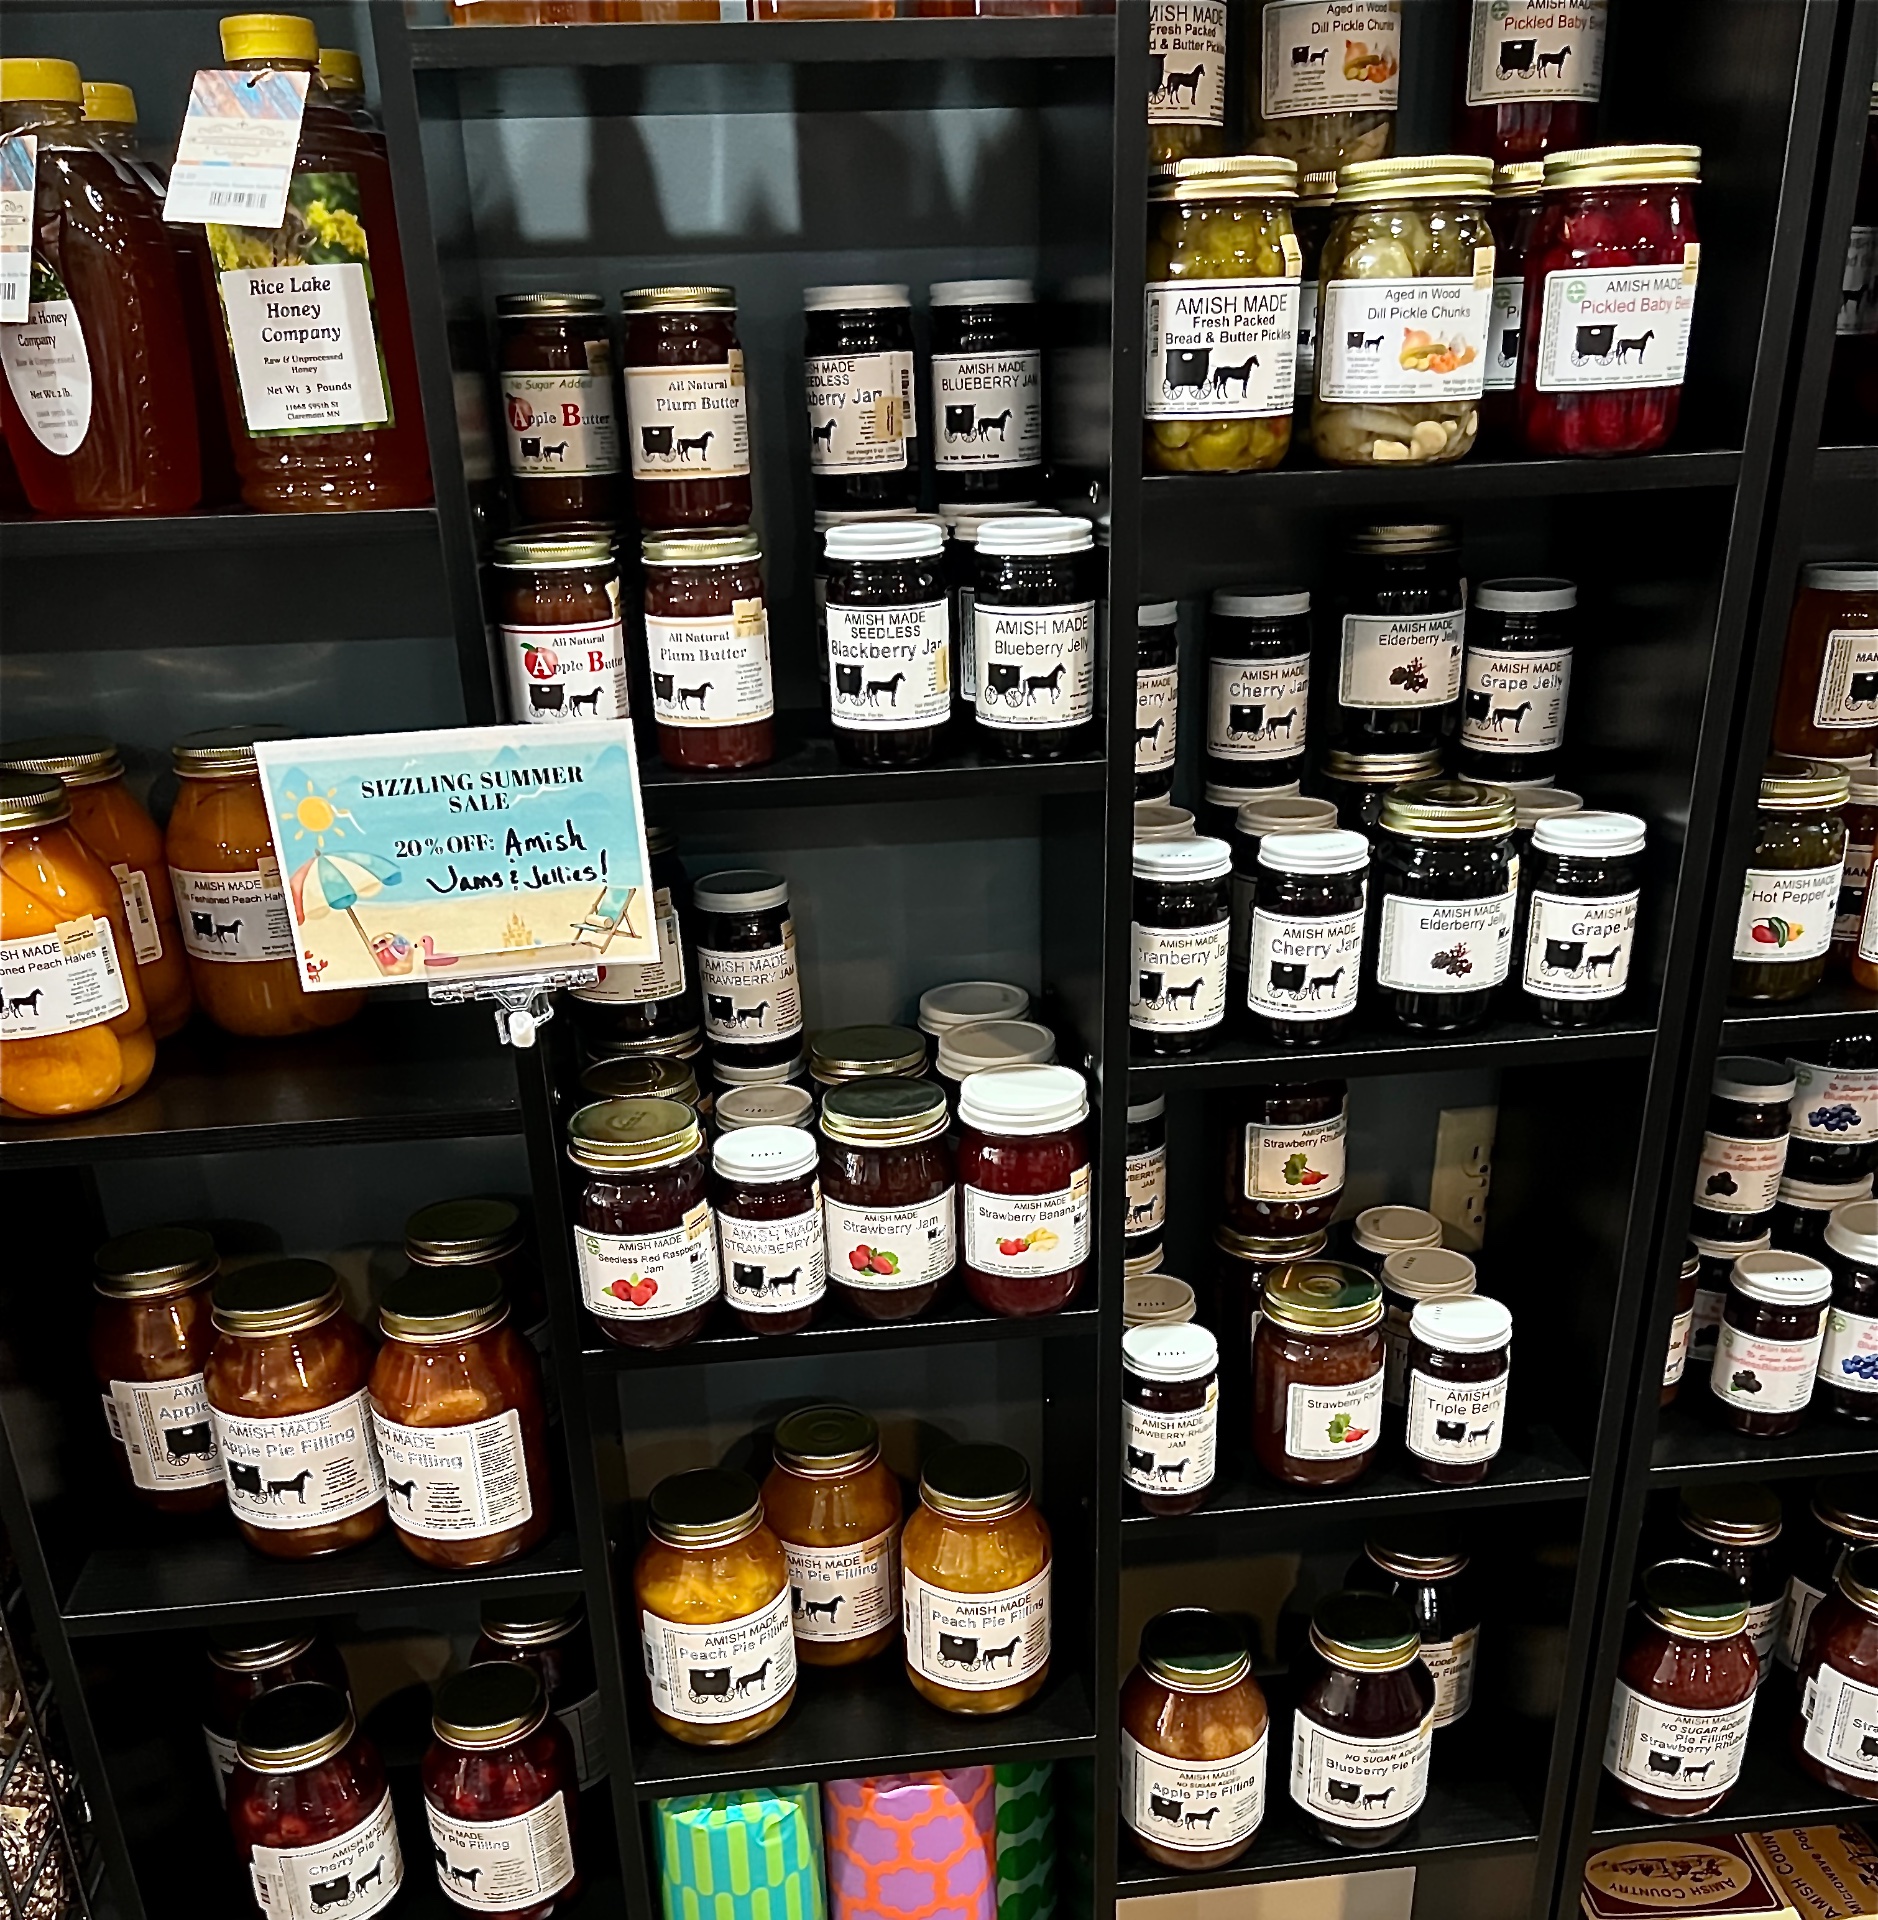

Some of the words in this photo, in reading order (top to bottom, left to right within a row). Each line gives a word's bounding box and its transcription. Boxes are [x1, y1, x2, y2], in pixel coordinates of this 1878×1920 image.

[1326, 3, 1353, 17] Aged
[1355, 4, 1364, 13] in
[1184, 23, 1217, 38] Packed
[1311, 21, 1329, 35] Dill
[1332, 19, 1365, 32] Pickle
[1504, 13, 1554, 31] Pickled
[1557, 14, 1587, 33] Baby
[1172, 38, 1205, 51] Butter
[249, 278, 285, 296] Rice
[289, 276, 332, 293] Lake
[1605, 279, 1650, 294] AMISH
[1384, 288, 1416, 303] Aged
[1417, 289, 1428, 300] in
[1431, 287, 1461, 300] Wood
[266, 302, 322, 320] Honey
[1175, 296, 1239, 316] AMISH
[1243, 293, 1288, 314] MADE
[1367, 307, 1387, 320] Dill
[1390, 305, 1428, 319] Pickle
[1431, 305, 1471, 319] Chunks
[1580, 299, 1637, 316] Pickled
[1640, 297, 1674, 314] Baby
[37, 310, 68, 327] Honey
[1192, 315, 1231, 329] Fresh
[1233, 313, 1276, 328] Packed
[17, 333, 57, 350] Company
[261, 326, 342, 344] Company
[1164, 331, 1201, 345] Bread
[1205, 331, 1216, 343] &
[1219, 330, 1260, 344] Butter
[291, 352, 344, 364] Unprocessed
[291, 366, 318, 374] Honey
[821, 360, 856, 374] MADE
[957, 363, 995, 376] AMISH
[266, 385, 284, 396] Net
[305, 386, 312, 395] 3
[316, 382, 353, 393] Pounds
[523, 378, 556, 392] Sugar
[941, 375, 1019, 391] BLUEBERRY
[655, 397, 697, 412] Plum
[700, 396, 740, 411] Butter
[326, 410, 341, 418] MN
[843, 613, 885, 628] AMISH
[888, 610, 927, 625] MADE
[995, 619, 1047, 636] AMISH
[1051, 615, 1089, 634] MADE
[850, 624, 922, 640] SEEDLESS
[1390, 621, 1428, 634] AMISH
[568, 632, 606, 646] Natural
[689, 629, 731, 643] Natural
[1378, 632, 1440, 647] Elderberry
[659, 647, 696, 663] Plum
[698, 646, 748, 662] Butter
[831, 639, 917, 662] Blackberry
[994, 641, 1064, 658] Blueberry
[1240, 668, 1280, 682] AMISH
[1490, 661, 1530, 674] AMISH
[1532, 660, 1562, 674] MADE
[1229, 681, 1287, 701] Cherry
[1480, 673, 1529, 693] Grape
[1532, 673, 1563, 692] Jelly
[360, 772, 474, 800] SIZZLING
[479, 765, 585, 791] SUMMER
[448, 792, 511, 815] SALE
[504, 818, 588, 857] Amish
[426, 865, 504, 894] Jams
[522, 849, 609, 891] Jellies!
[193, 879, 227, 892] AMISH
[227, 879, 263, 892] MADE
[1773, 879, 1811, 890] AMISH
[231, 892, 263, 905] Peach
[1751, 890, 1778, 903] Hot
[1781, 889, 1826, 905] Pepper
[1432, 907, 1472, 919] AMISH
[1473, 902, 1502, 917] MADE
[1583, 907, 1623, 921] AMISH
[1282, 927, 1324, 940] AMISH
[1327, 921, 1356, 938] MADE
[1419, 917, 1486, 932] Elderberry
[1570, 921, 1622, 940] Grape
[21, 941, 61, 958] MADE
[1158, 938, 1193, 949] AMISH
[1271, 938, 1332, 960] Cherry
[27, 957, 63, 973] Peach
[64, 949, 97, 965] Halves
[704, 958, 746, 974] AMISH
[749, 952, 788, 973] MADE
[1263, 1136, 1318, 1149] Strawberry
[978, 1206, 1037, 1224] Strawberry
[1038, 1205, 1077, 1222] Banana
[1013, 1201, 1043, 1212] AMISH
[842, 1219, 913, 1237] Strawberry
[915, 1214, 940, 1231] Jam
[863, 1213, 893, 1223] AMISH
[617, 1241, 652, 1253] AMISH
[723, 1235, 810, 1256] STRAWBERRY
[597, 1253, 639, 1265] Seedless
[640, 1252, 662, 1263] Red
[643, 1263, 665, 1275] Jam
[1307, 1395, 1362, 1410] Strawberry
[1445, 1391, 1491, 1403] AMISH
[1426, 1397, 1468, 1416] Triple
[227, 1423, 276, 1440] AMISH
[280, 1415, 333, 1440] MADE
[1141, 1418, 1176, 1431] AMISH
[221, 1435, 262, 1458] Apple
[265, 1442, 296, 1459] Pie
[300, 1426, 357, 1455] Filling
[392, 1431, 437, 1450] MADE
[1167, 1440, 1187, 1450] JAM
[407, 1451, 464, 1470] Filling
[824, 1555, 861, 1570] MADE
[807, 1569, 832, 1582] Pie
[835, 1561, 879, 1580] Filling
[931, 1609, 977, 1629] Peach
[981, 1616, 1006, 1629] Pie
[1010, 1596, 1045, 1624] Filling
[954, 1605, 998, 1617] AMISH
[999, 1592, 1032, 1614] MADE
[679, 1647, 728, 1661] Peach
[758, 1614, 789, 1646] Filling
[704, 1630, 747, 1648] AMISH
[748, 1612, 779, 1637] MADE
[1660, 1722, 1678, 1732] NO
[1680, 1726, 1719, 1735] SUGAR
[1639, 1732, 1712, 1756] Strawberry
[1674, 1733, 1696, 1744] Pie
[1699, 1730, 1735, 1744] Filling
[1325, 1757, 1389, 1777] Blueberry
[1391, 1761, 1409, 1773] Pie
[1362, 1754, 1398, 1764] SUGAR
[1221, 1775, 1256, 1797] Filling
[467, 1839, 511, 1851] Filling
[308, 1856, 354, 1876] Cherry
[1608, 1882, 1687, 1900] COUNTRY
[1691, 1877, 1738, 1898] AMISH
[1789, 1877, 1842, 1920] AMISH
